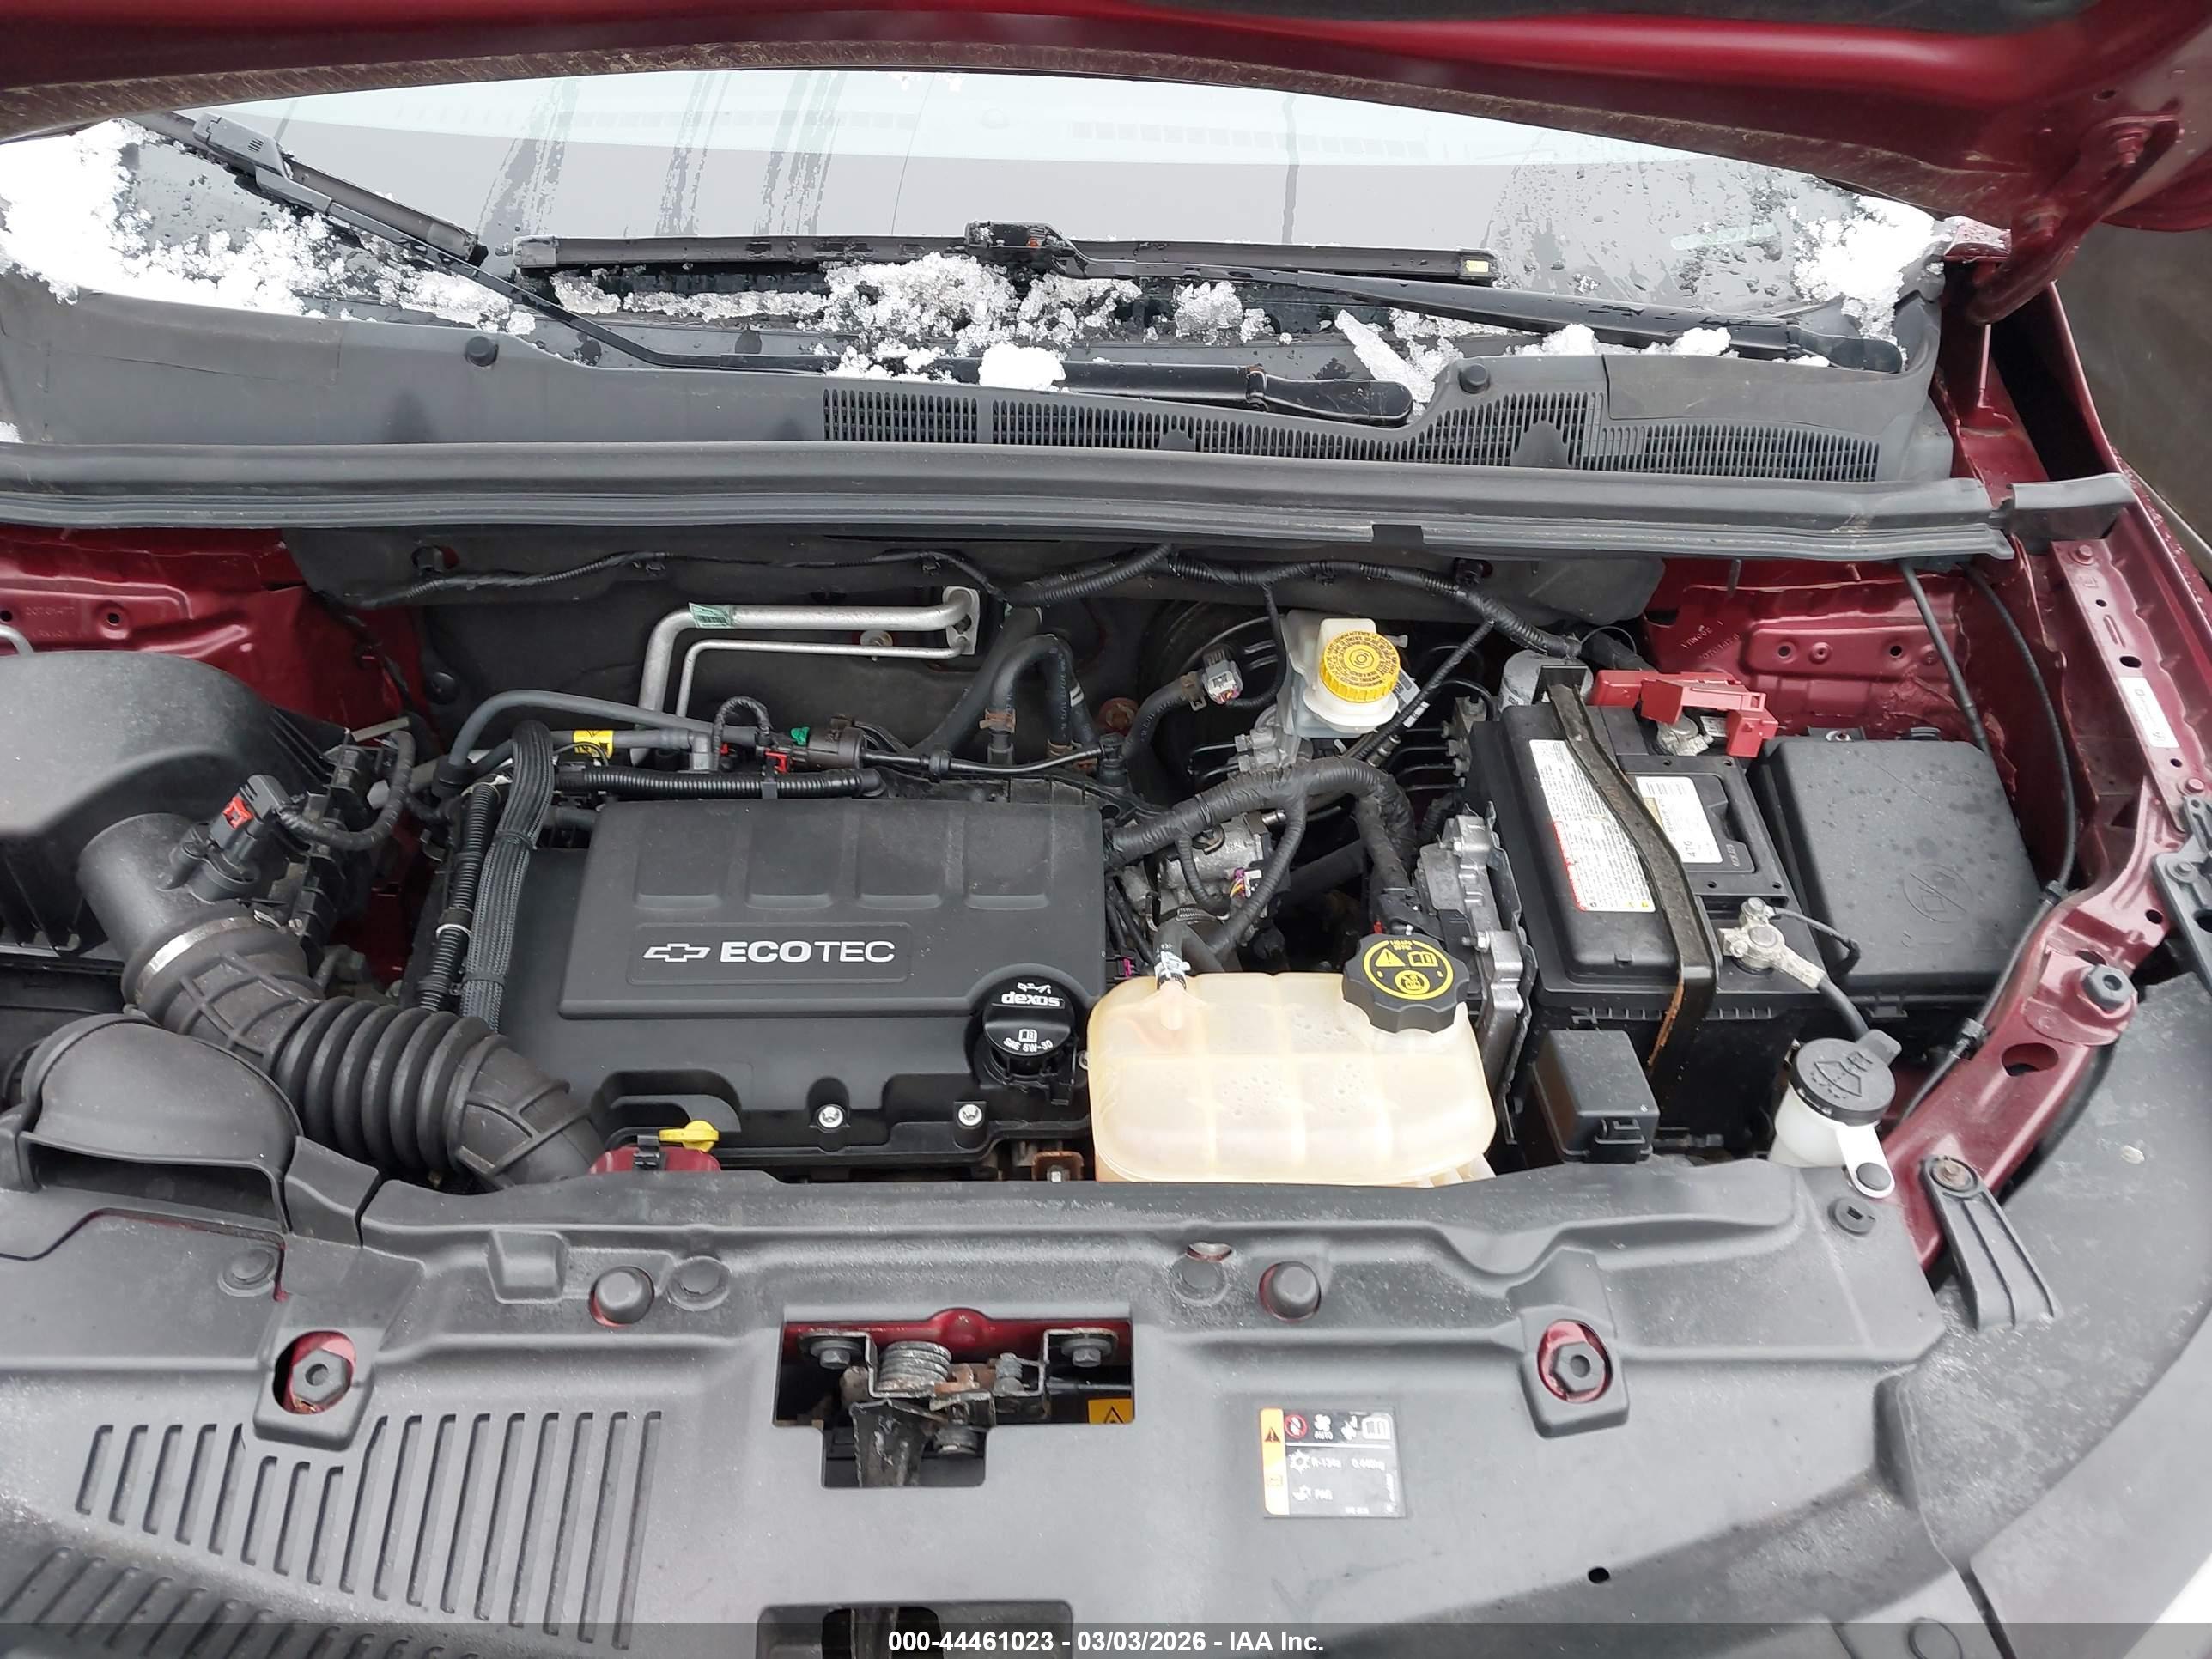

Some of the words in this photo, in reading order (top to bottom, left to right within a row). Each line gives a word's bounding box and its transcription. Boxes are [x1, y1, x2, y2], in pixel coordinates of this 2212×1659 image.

[720, 941, 895, 963] ECOTEC
[1001, 991, 1060, 1007] dexos
[1003, 1037, 1021, 1051] SAE
[1023, 1040, 1054, 1052] 5W-30
[1314, 1431, 1334, 1440] AUTO
